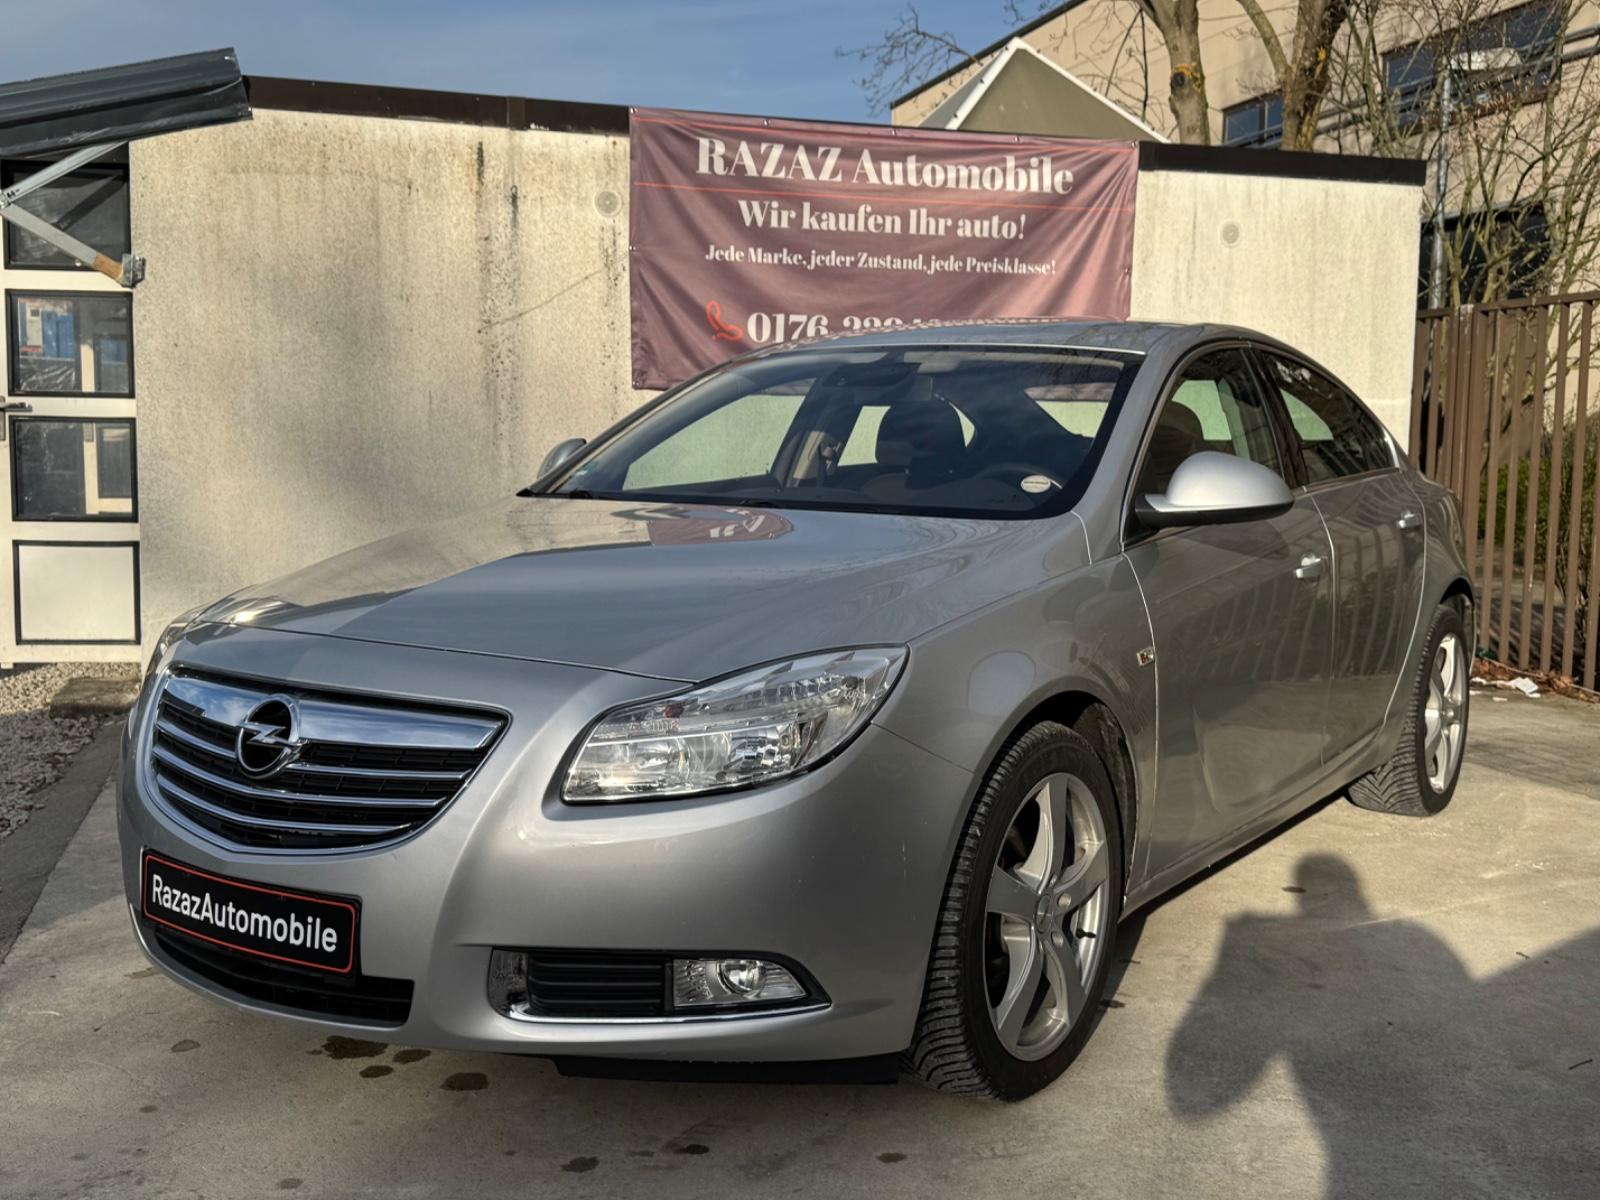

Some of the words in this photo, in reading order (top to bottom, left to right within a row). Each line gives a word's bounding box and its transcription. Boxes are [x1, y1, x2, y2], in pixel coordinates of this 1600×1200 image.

[696, 137, 842, 182] RAZAZ
[852, 149, 1074, 194] Automobile
[739, 200, 796, 229] Wir
[802, 202, 902, 235] kaufen
[909, 208, 952, 236] Ihr
[957, 214, 1026, 240] auto!
[705, 245, 745, 262] Jede
[966, 257, 1056, 274] Preisklasse!
[747, 312, 829, 343] 0176
[152, 874, 338, 952] RazazAutomobile
